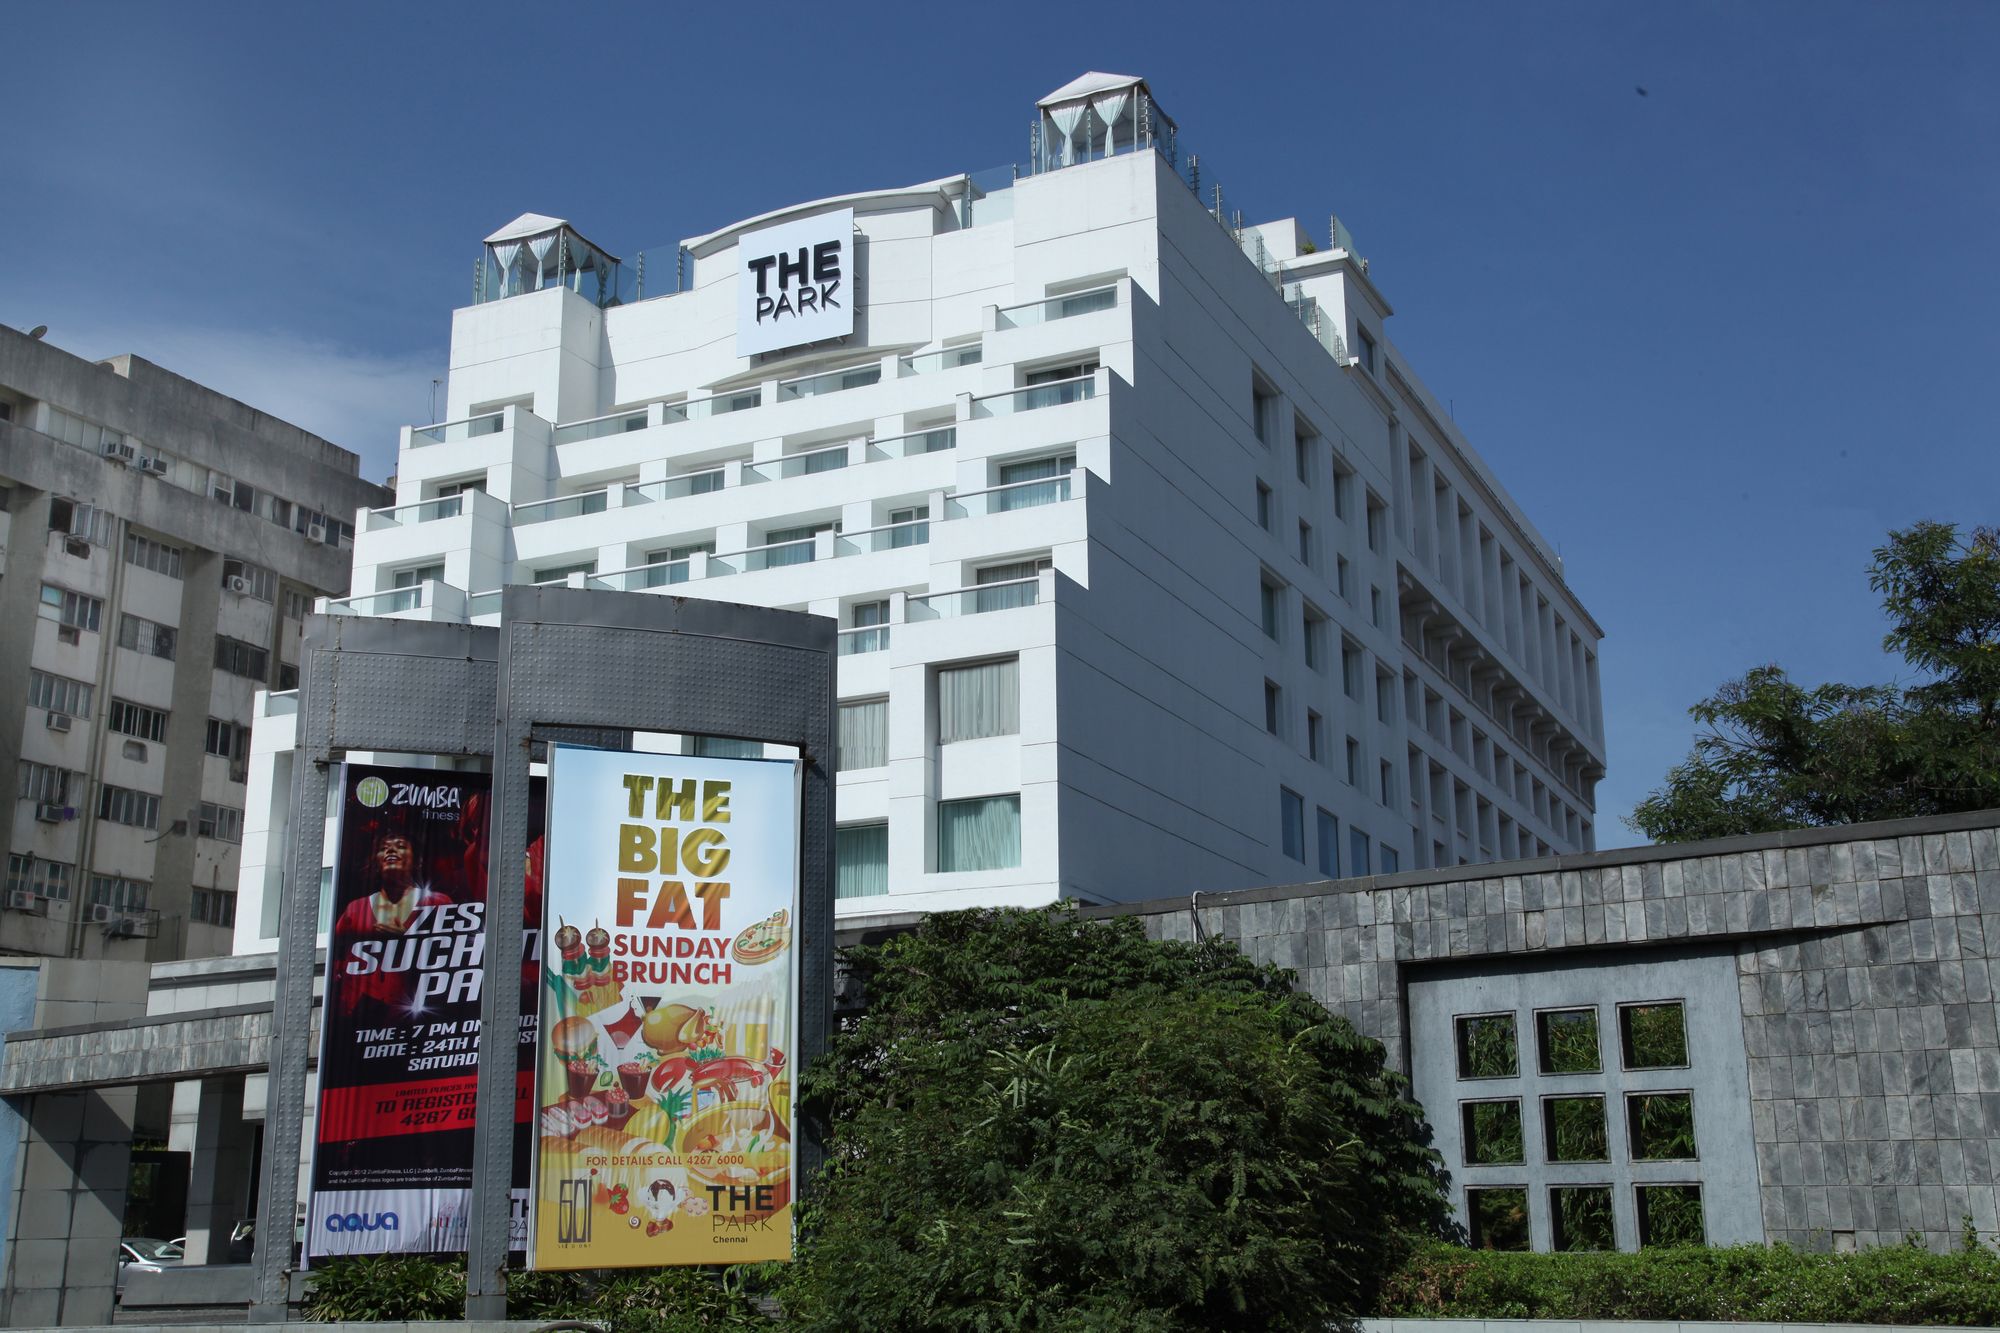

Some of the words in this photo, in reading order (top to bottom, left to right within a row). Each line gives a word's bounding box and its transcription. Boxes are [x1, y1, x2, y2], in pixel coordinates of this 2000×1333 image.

[748, 240, 841, 295] THE
[757, 280, 841, 325] PARK
[391, 783, 460, 808] ZUMBA
[623, 774, 731, 823] THE
[618, 823, 731, 878] BIG
[616, 878, 731, 930] FAT
[404, 902, 485, 935] ZES
[613, 933, 731, 959] SUNDAY
[612, 960, 731, 984] BRUNCH
[413, 969, 483, 1010] PA
[356, 1027, 397, 1043] TIME
[411, 1025, 424, 1038] 7
[428, 1022, 457, 1037] PM
[363, 1043, 408, 1059] DATE
[422, 1037, 469, 1054] 24TH
[407, 1052, 479, 1071] SATURD
[375, 1100, 396, 1114] TO
[400, 1109, 451, 1126] 4267
[586, 1156, 607, 1166] FOR
[612, 1156, 653, 1166] DETAILS
[657, 1155, 682, 1165] CALL
[687, 1155, 711, 1165] 4267
[717, 1155, 744, 1165] 6000
[706, 1185, 774, 1211] THE
[712, 1214, 774, 1233] PARK
[712, 1235, 748, 1244] Chennai
